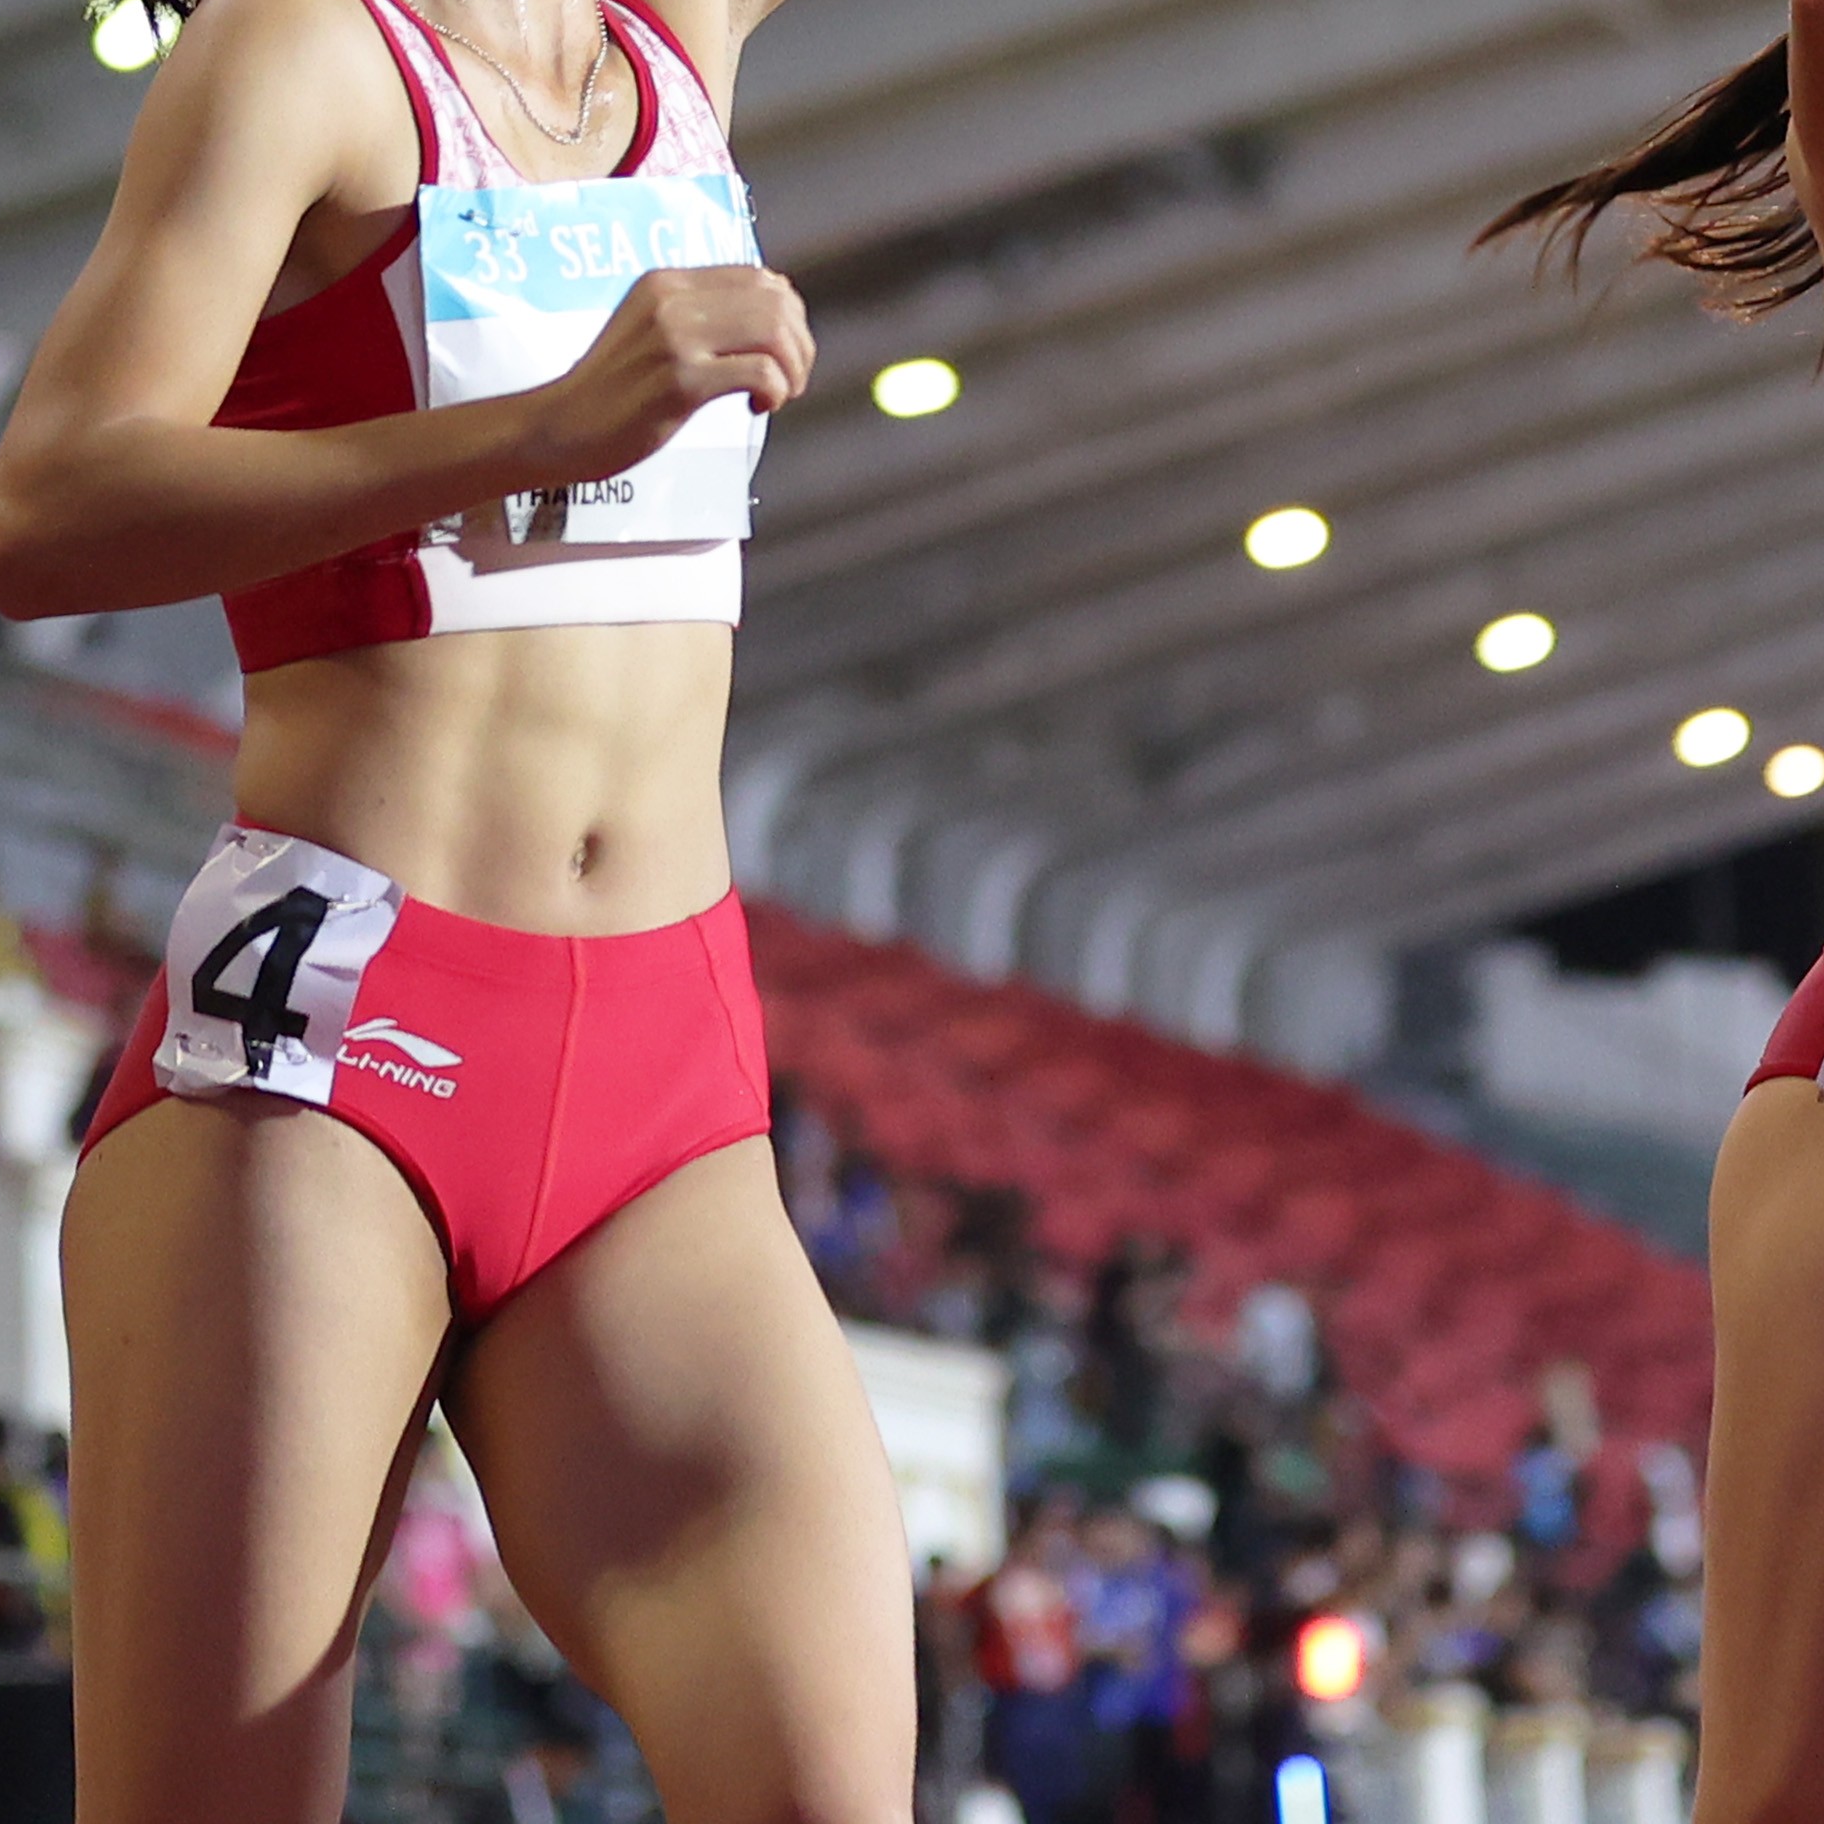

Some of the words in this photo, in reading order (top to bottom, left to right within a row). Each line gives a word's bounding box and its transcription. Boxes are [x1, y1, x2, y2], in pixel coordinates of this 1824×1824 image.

[550, 220, 635, 279] SEA
[192, 885, 329, 1080] 4
[335, 1044, 457, 1099] LI-NING
